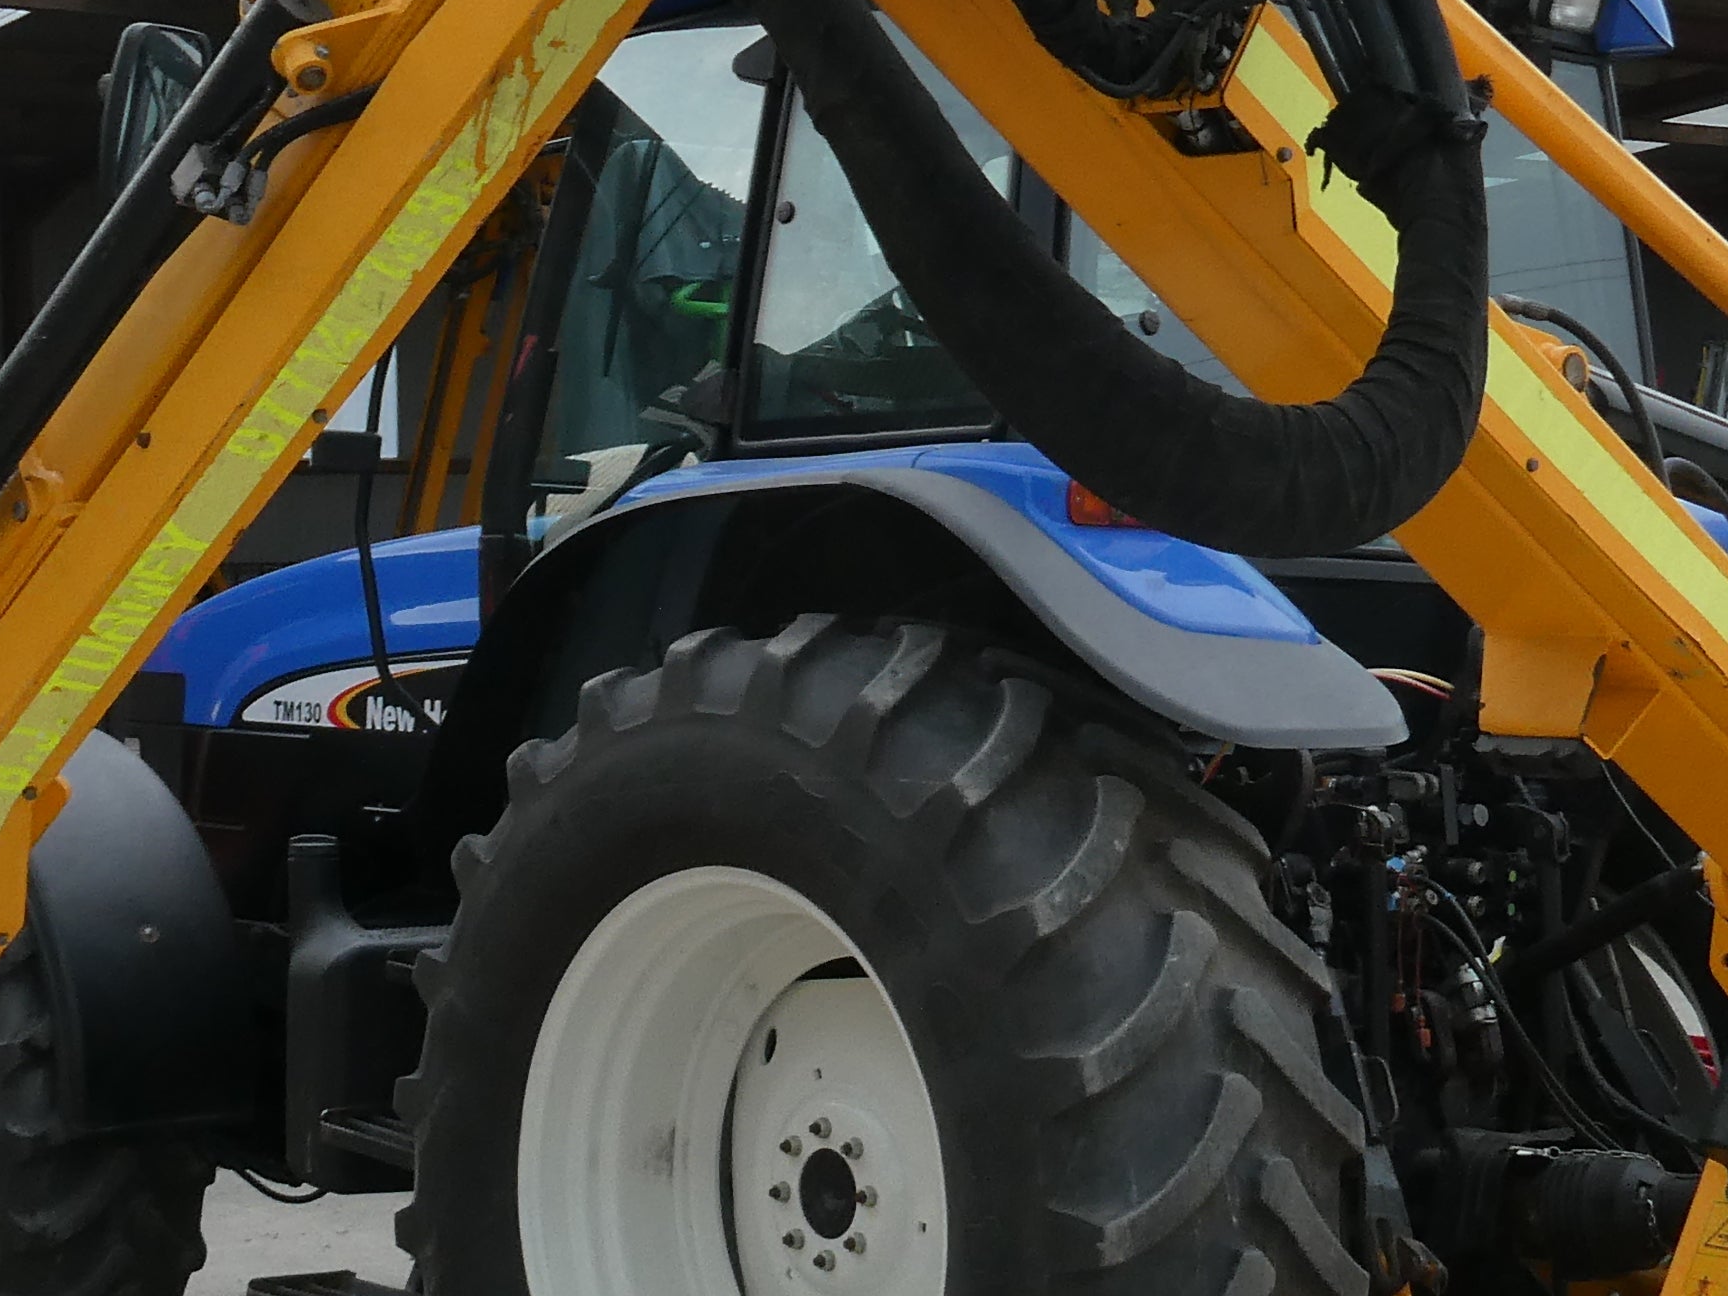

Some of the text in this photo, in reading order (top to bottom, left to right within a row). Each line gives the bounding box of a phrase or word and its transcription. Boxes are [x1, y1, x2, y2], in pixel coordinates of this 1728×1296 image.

[41, 519, 211, 696] TURNEY
[273, 699, 322, 723] TM130
[365, 695, 416, 733] New
